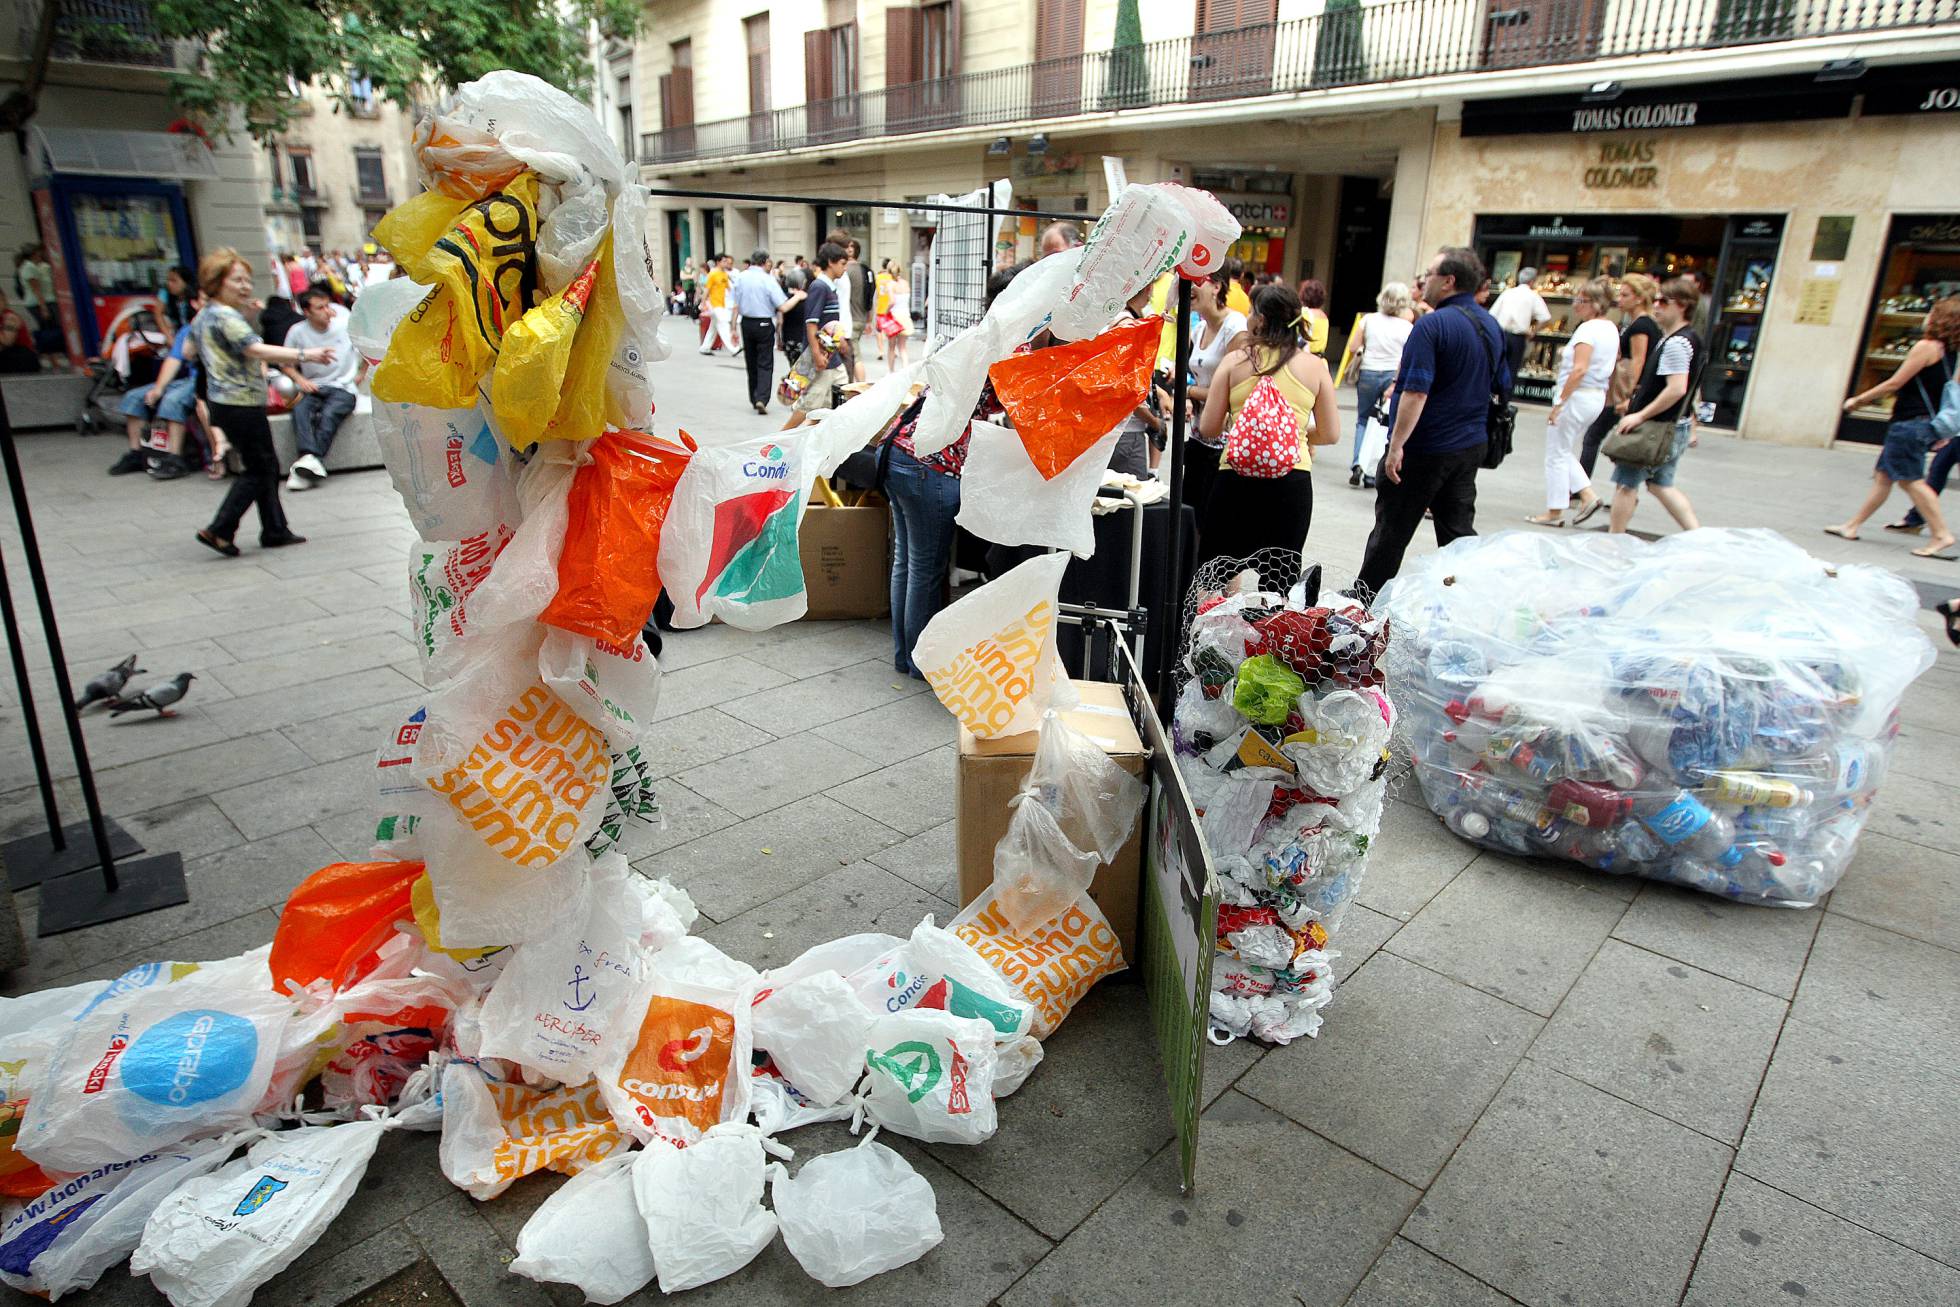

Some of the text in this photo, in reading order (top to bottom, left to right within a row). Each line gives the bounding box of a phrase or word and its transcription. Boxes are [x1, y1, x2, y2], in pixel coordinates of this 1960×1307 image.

[1573, 103, 1697, 131] TOMAS COLOMER
[1585, 140, 1657, 188] TOMAS COLOMER
[1230, 203, 1272, 219] atch
[483, 719, 597, 812] suma
[1001, 904, 1092, 986] suma
